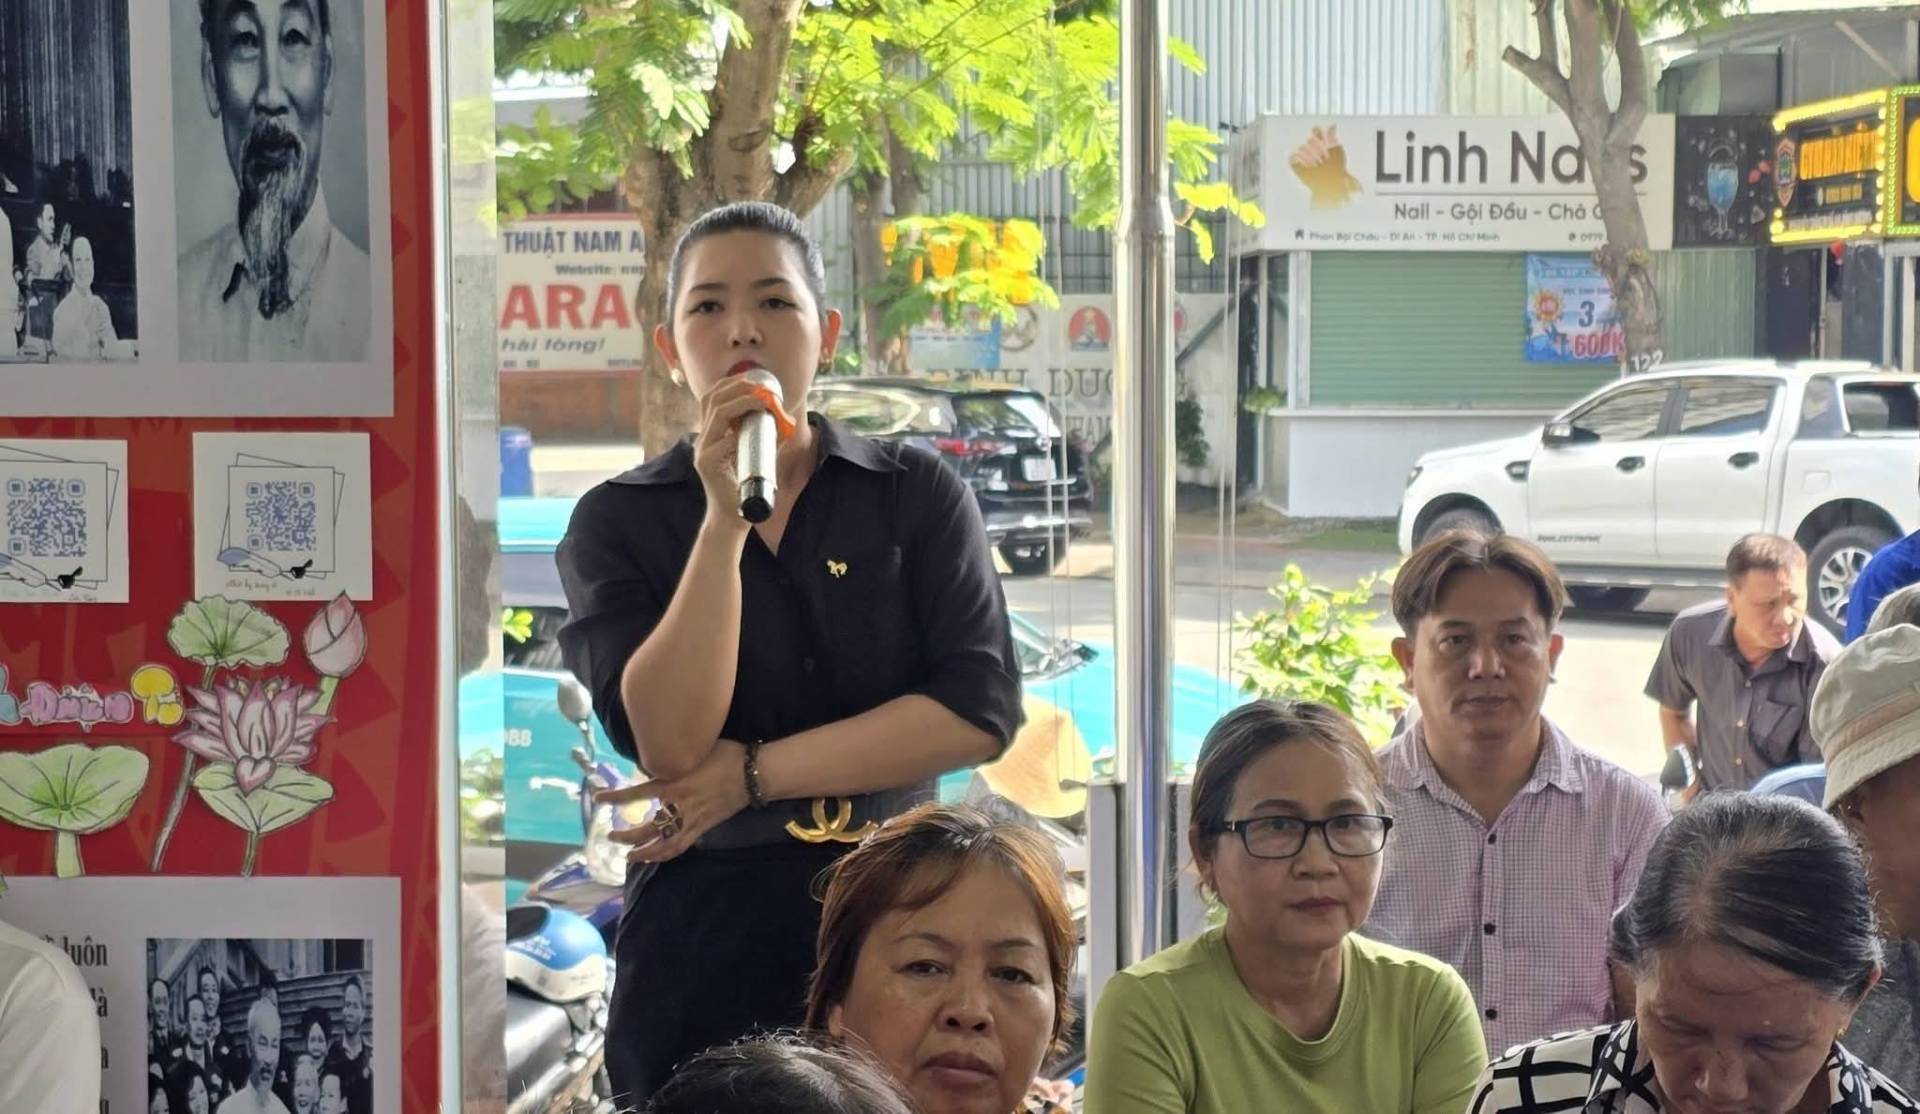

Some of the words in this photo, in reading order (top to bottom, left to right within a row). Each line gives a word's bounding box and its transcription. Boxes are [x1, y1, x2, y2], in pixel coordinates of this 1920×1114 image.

[1376, 130, 1488, 183] Linh
[1510, 130, 1649, 184] Nas
[1395, 203, 1430, 221] Nail
[503, 228, 566, 258] THUẬT
[574, 231, 621, 252] NAM
[500, 283, 631, 331] ARA
[1578, 300, 1596, 328] 3
[1573, 331, 1626, 358] 600K
[1631, 350, 1664, 372] 122
